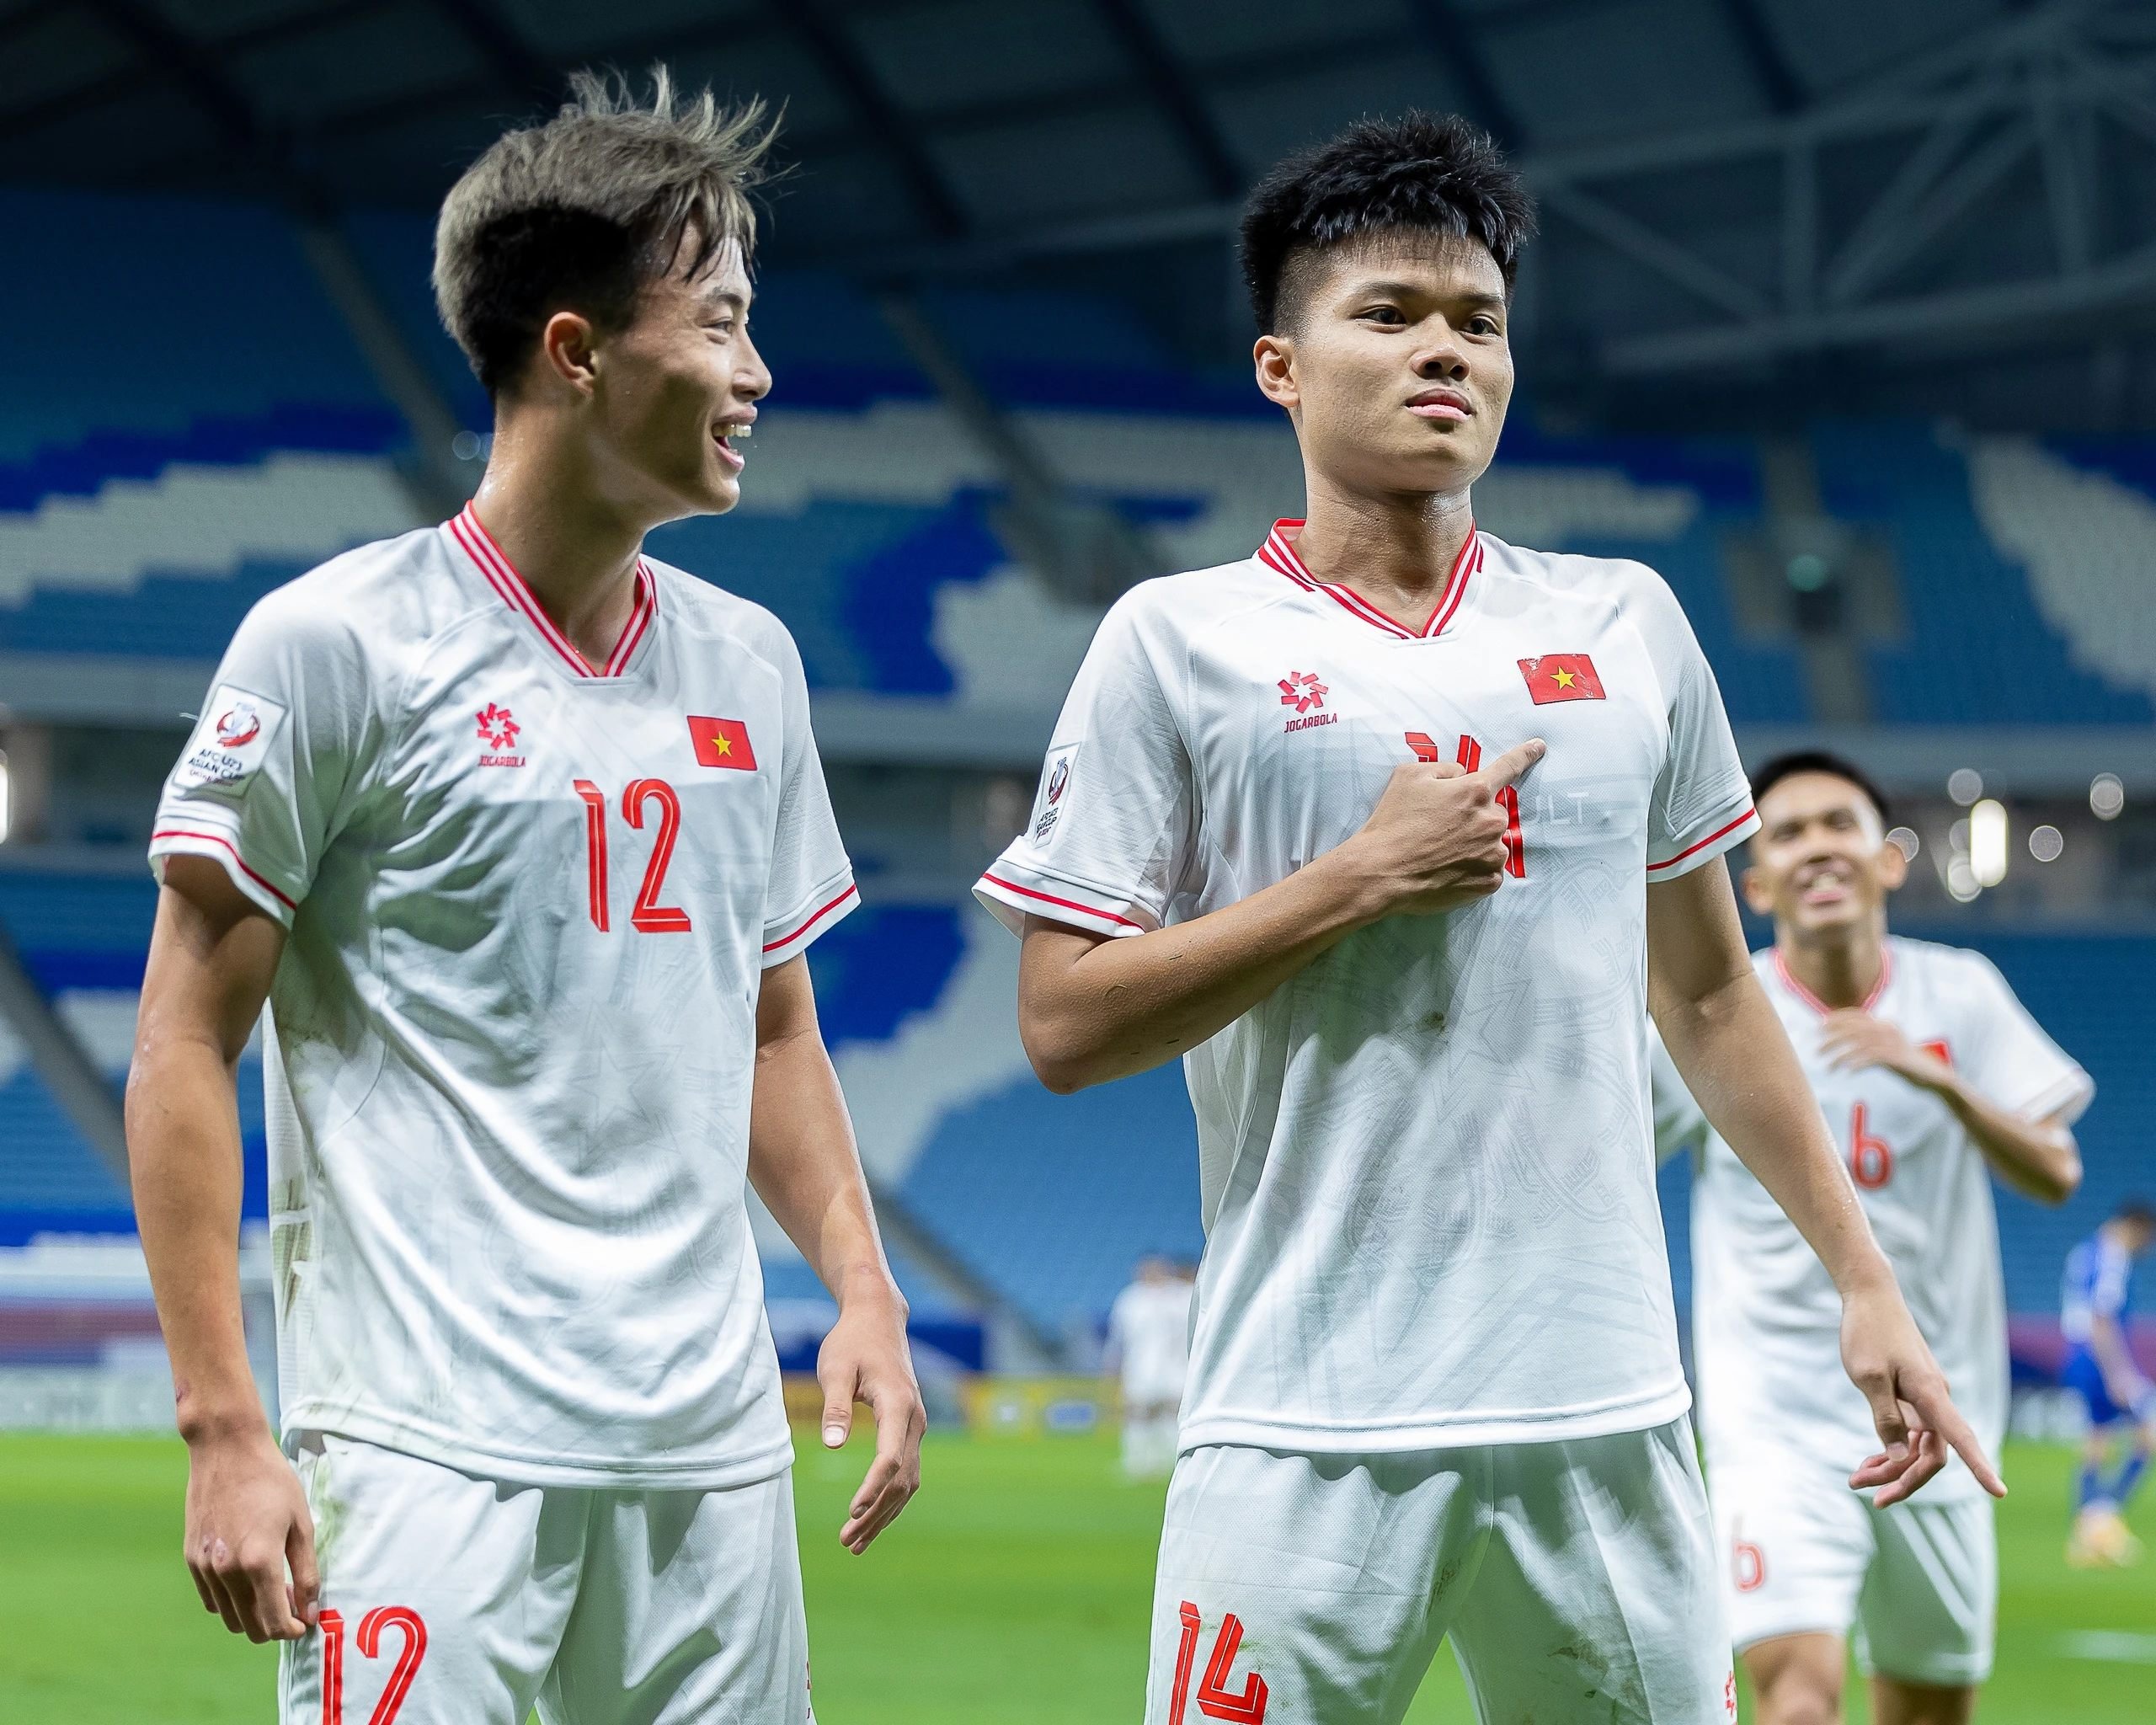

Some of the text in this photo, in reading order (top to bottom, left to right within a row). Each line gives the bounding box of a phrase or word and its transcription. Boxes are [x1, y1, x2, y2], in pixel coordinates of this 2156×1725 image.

[1283, 713, 1337, 734] JOGARBOLA
[573, 778, 692, 933] 12
[1851, 1103, 1892, 1191] 6
[321, 1605, 428, 1725] 12
[1167, 1599, 1270, 1725] 14
